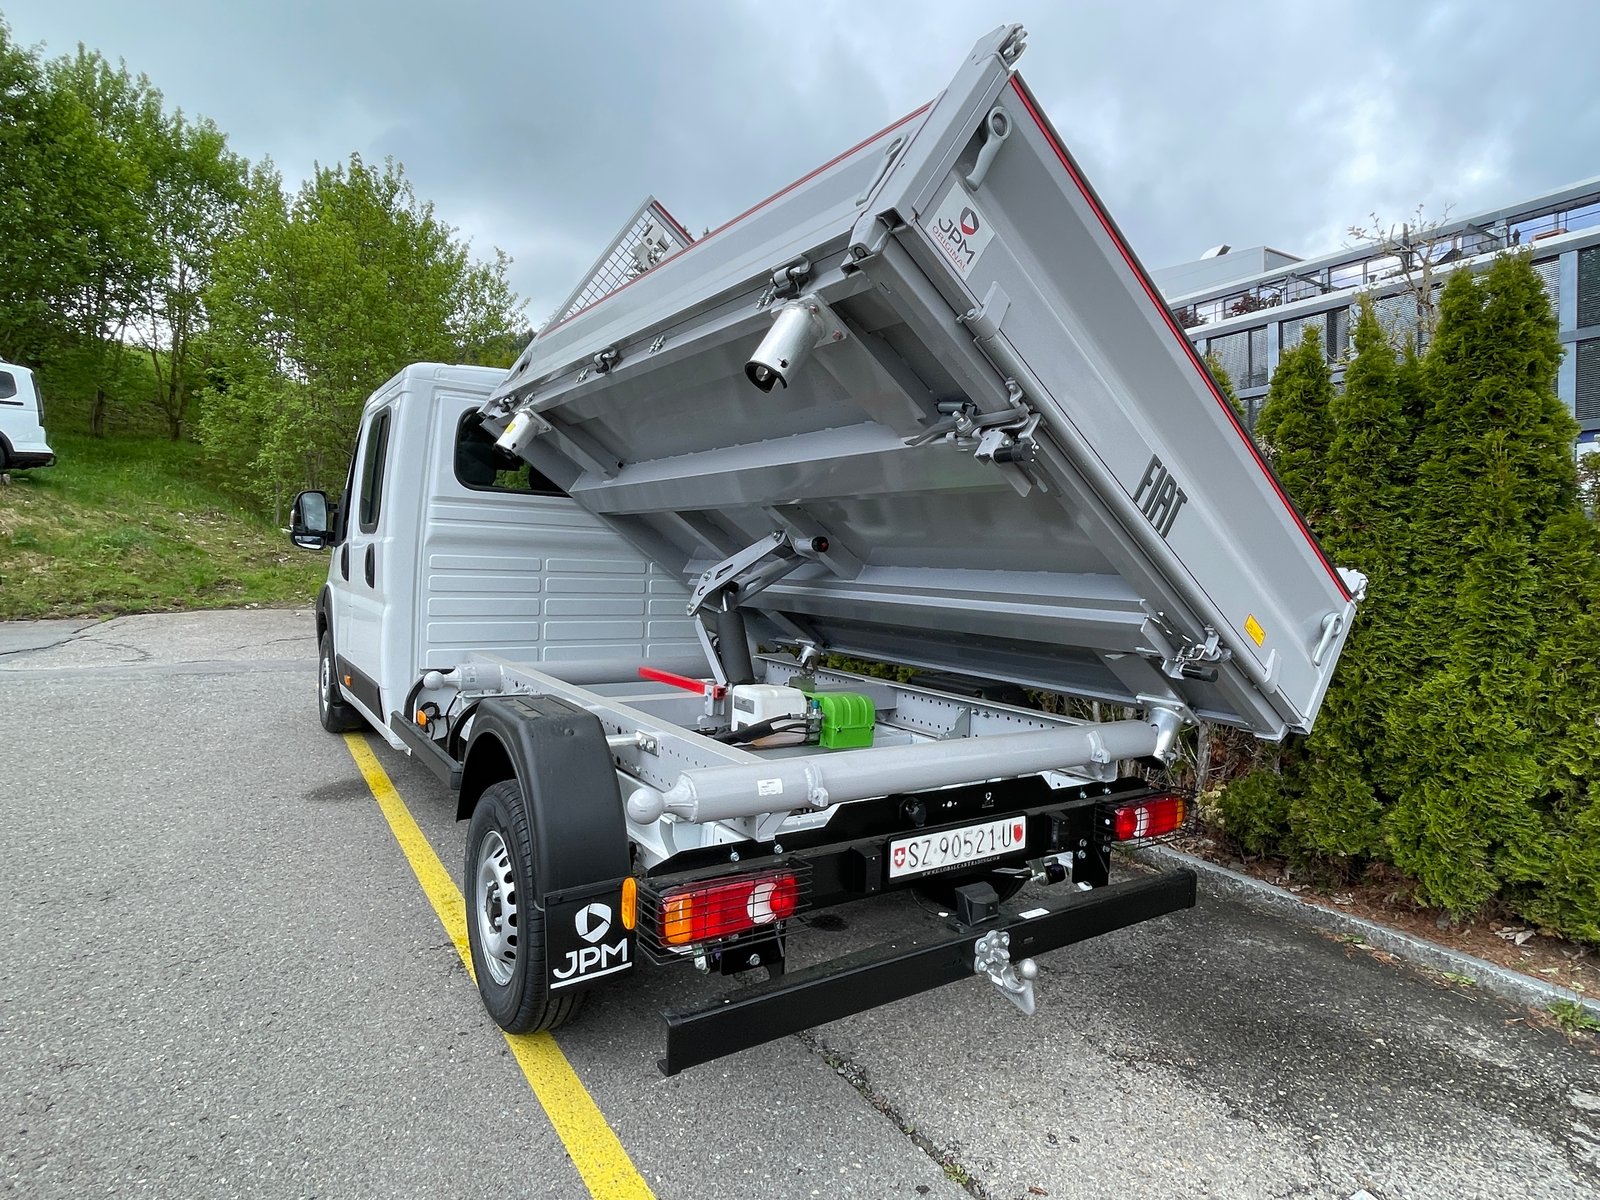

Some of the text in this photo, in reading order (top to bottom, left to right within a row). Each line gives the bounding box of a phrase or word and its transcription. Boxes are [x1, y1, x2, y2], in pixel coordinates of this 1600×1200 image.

[932, 225, 967, 273] ORIGINAL
[939, 218, 975, 264] JPM
[1132, 454, 1188, 538] FIAT
[552, 937, 628, 979] JPM
